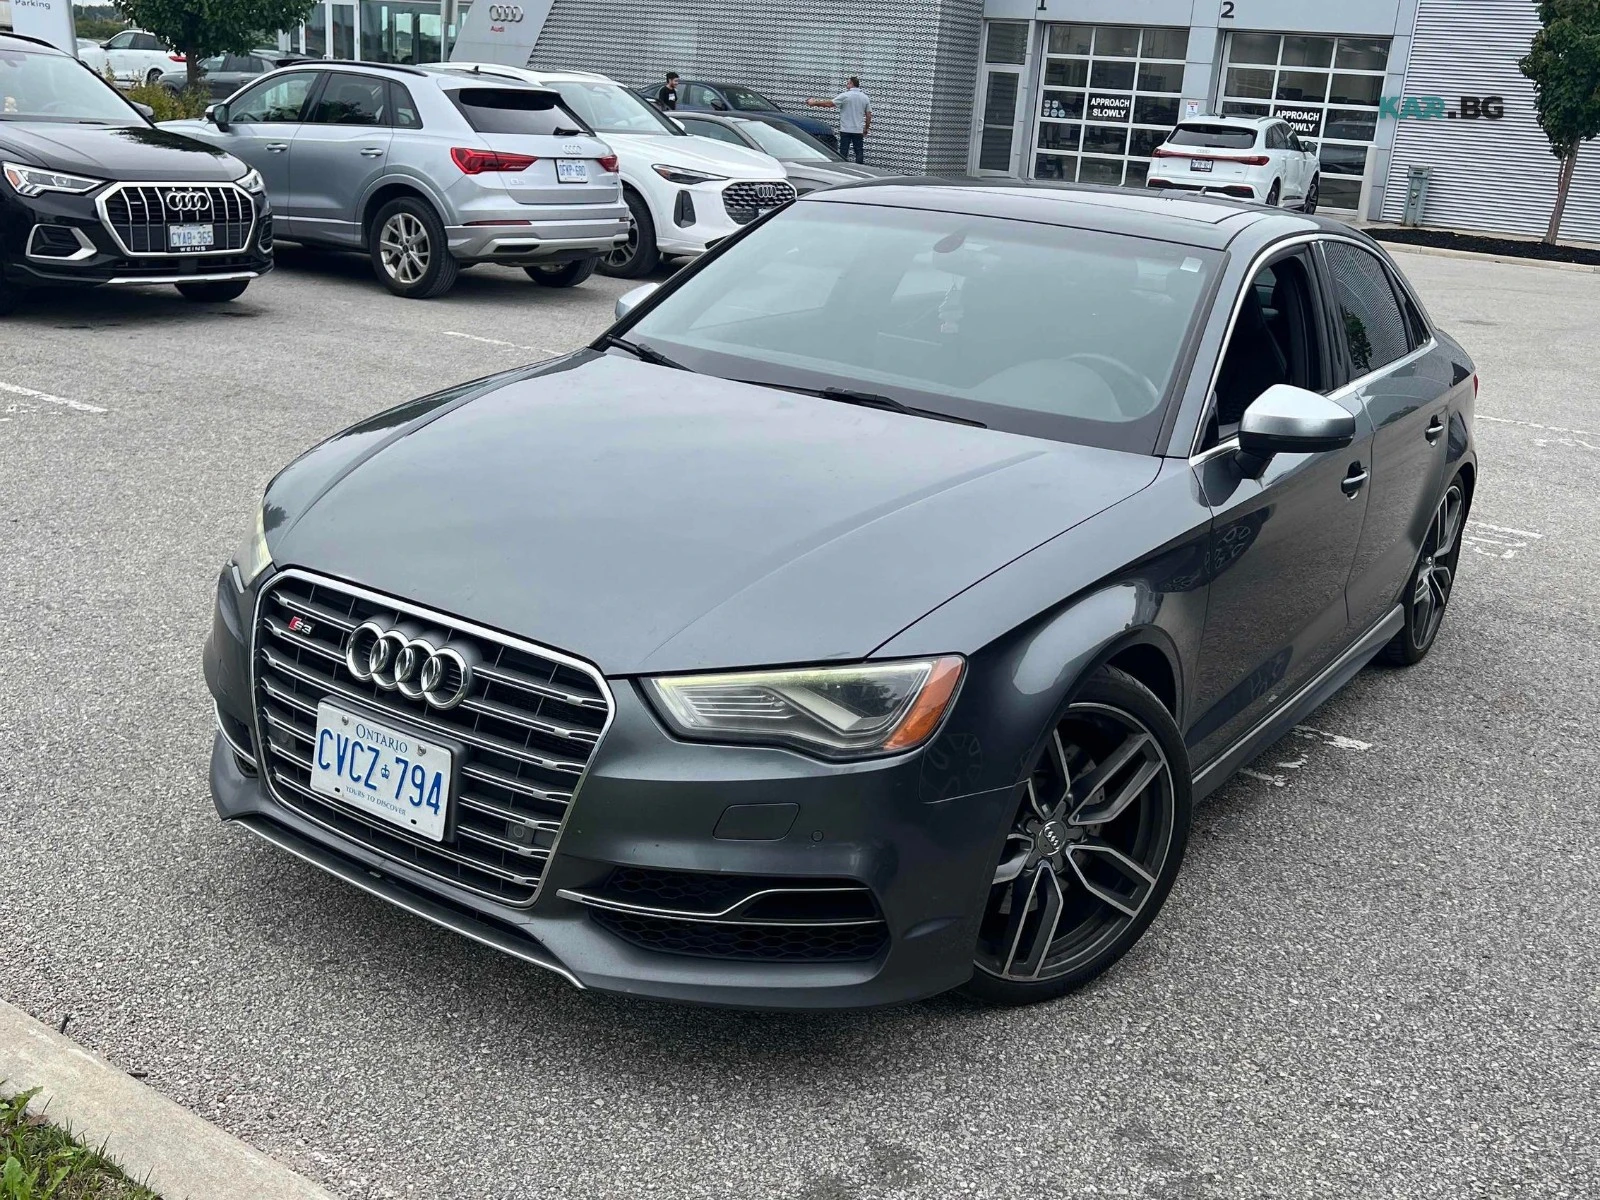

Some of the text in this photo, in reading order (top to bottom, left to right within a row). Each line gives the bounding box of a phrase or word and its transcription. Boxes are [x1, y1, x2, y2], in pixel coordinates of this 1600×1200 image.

[15, 0, 51, 10] Parking
[1220, 1, 1235, 19] 2
[1090, 97, 1130, 108] APPROACH
[1092, 108, 1127, 118] SLOWLY
[1275, 110, 1320, 121] APPROACH
[1288, 121, 1316, 132] OWLY
[290, 617, 312, 635] S3
[355, 723, 408, 754] ONTARIO
[345, 785, 407, 816] YOURS TO DISCOVER
